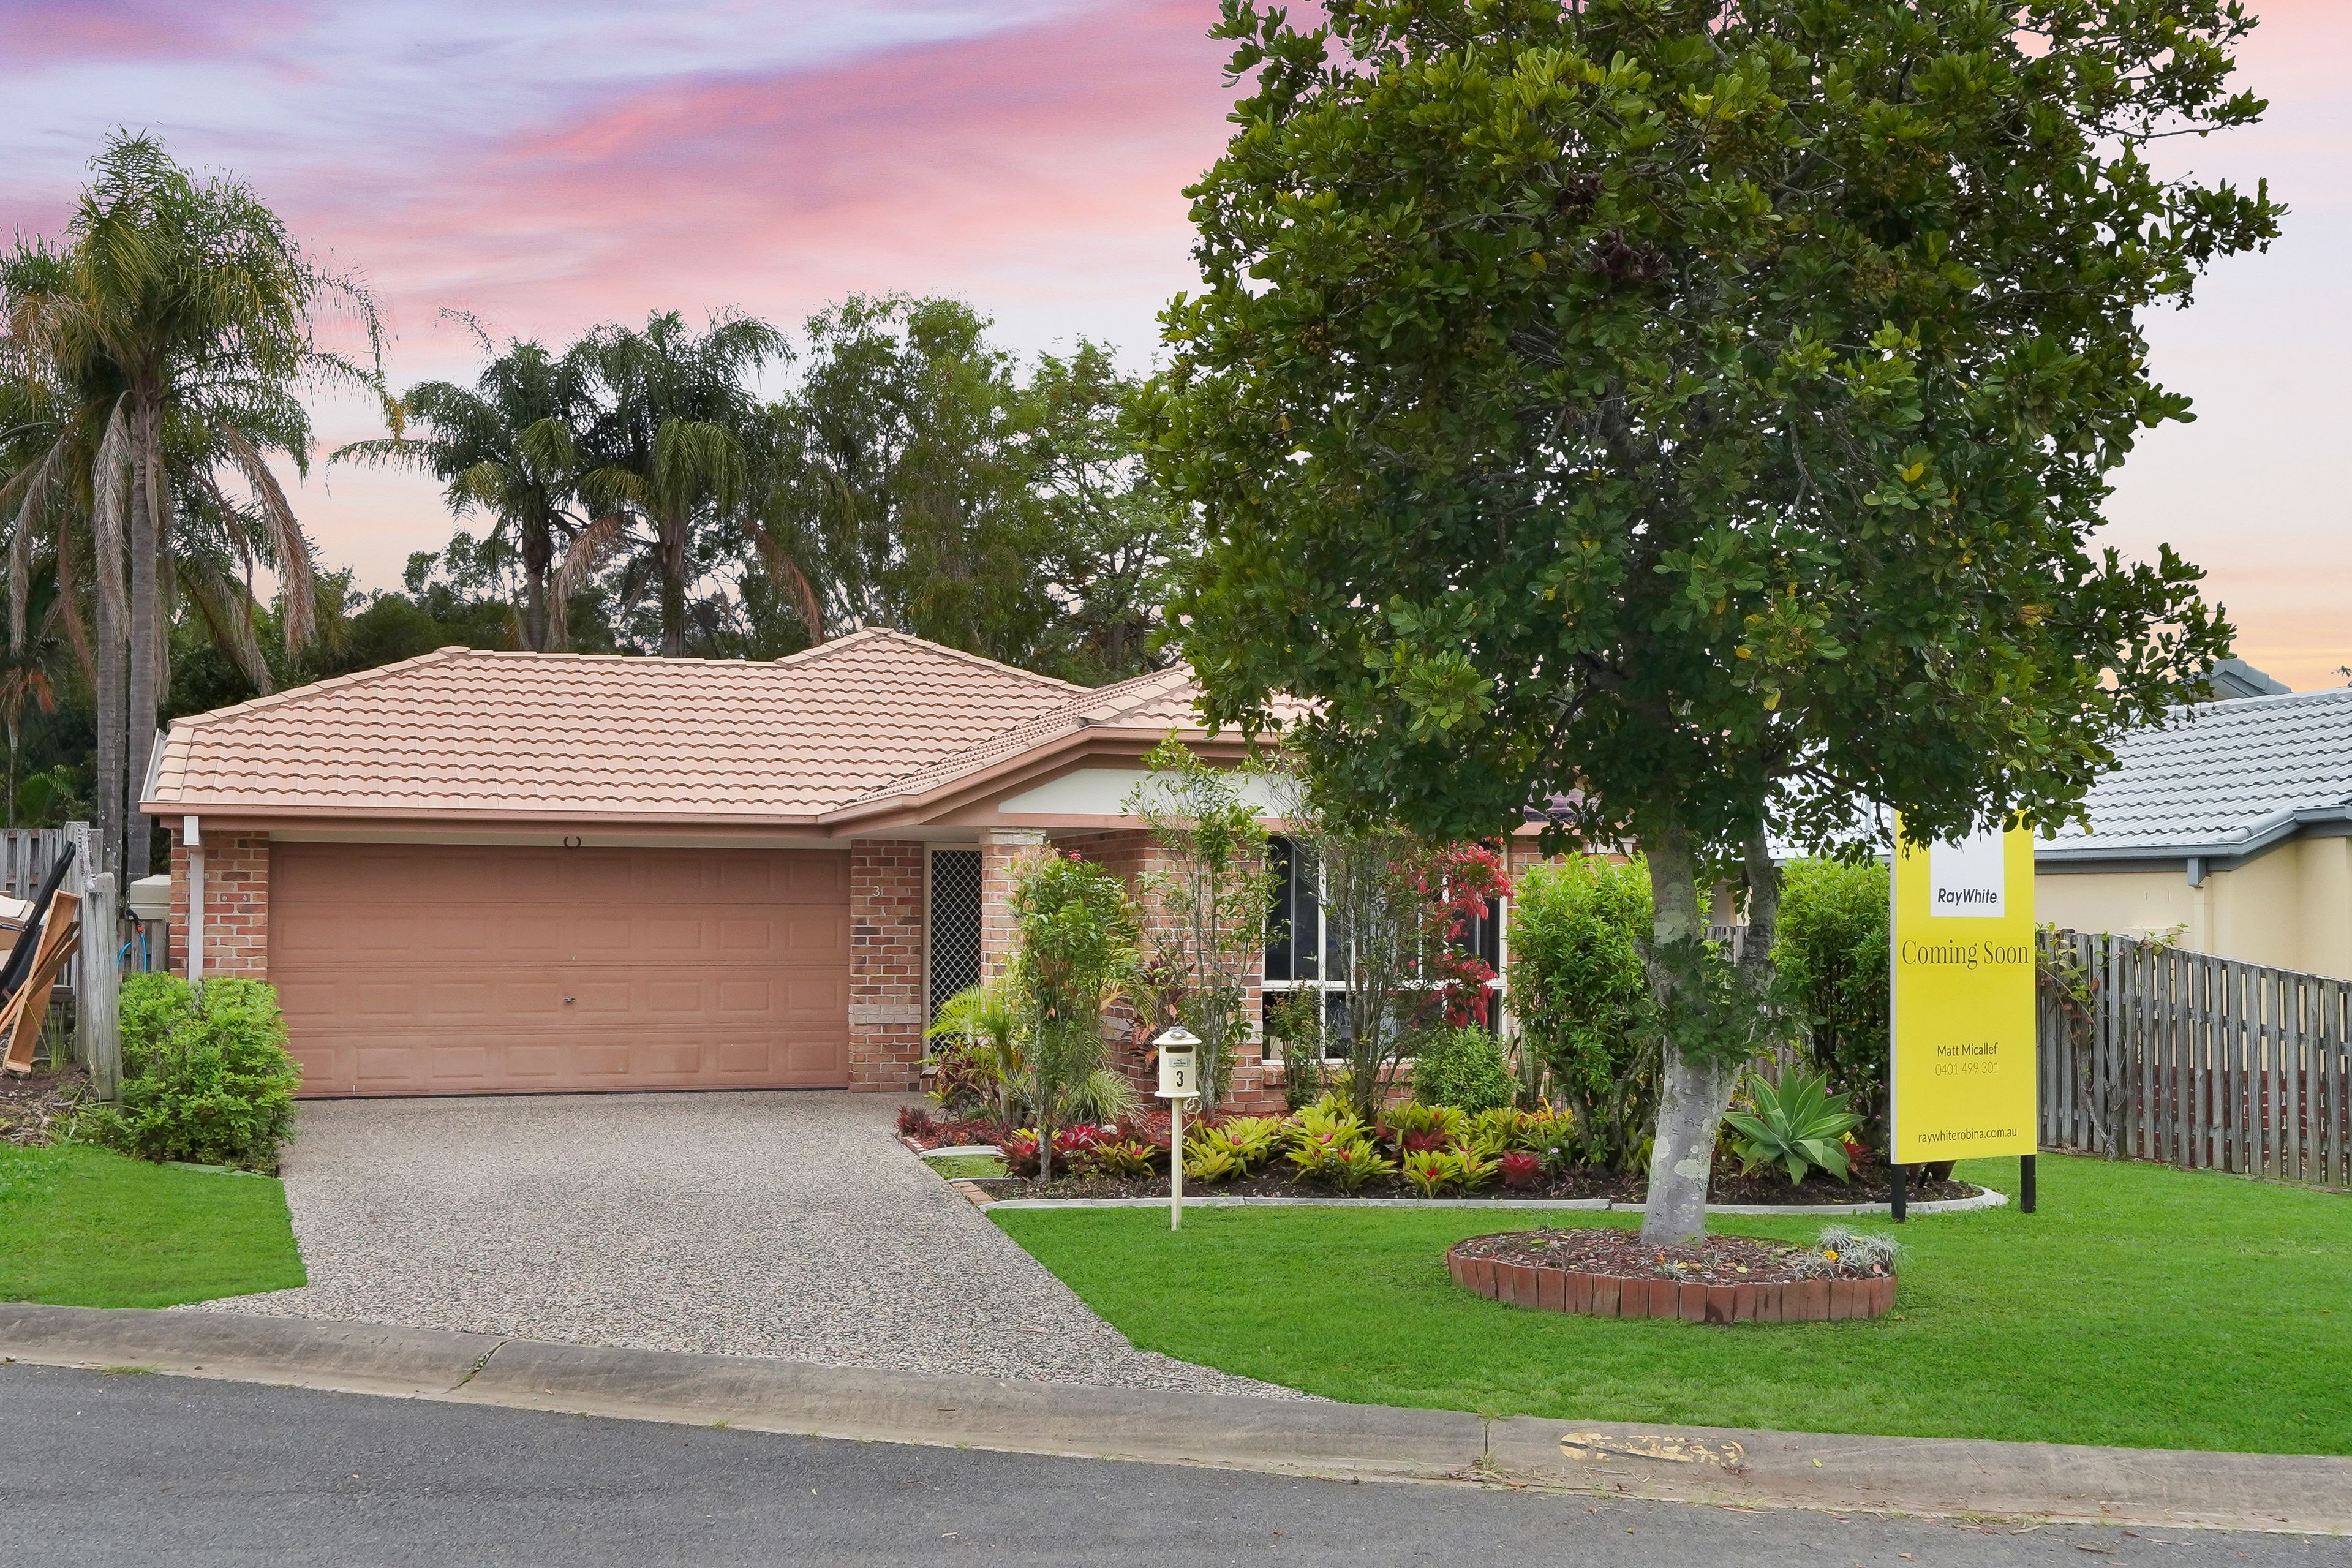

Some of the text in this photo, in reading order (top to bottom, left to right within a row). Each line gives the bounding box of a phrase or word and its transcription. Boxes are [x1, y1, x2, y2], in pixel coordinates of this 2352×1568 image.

[872, 886, 880, 897] 3
[1902, 939, 2029, 970] Coming Soon
[1937, 1042, 1999, 1057] Matt Micallef
[1935, 1061, 1999, 1076] 0401 499 301
[1176, 1071, 1183, 1087] 3
[1918, 1128, 2017, 1145] raywhiterobina.com.au
